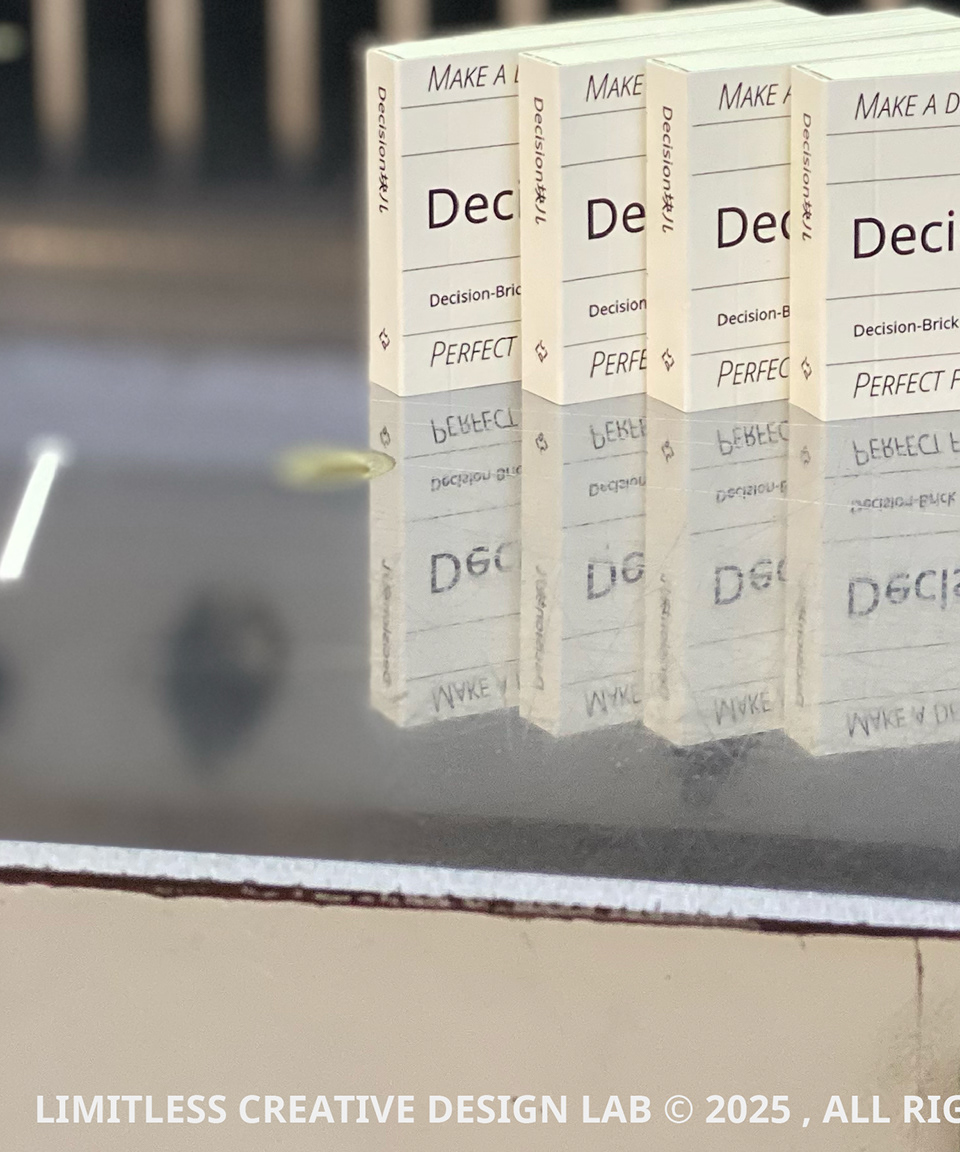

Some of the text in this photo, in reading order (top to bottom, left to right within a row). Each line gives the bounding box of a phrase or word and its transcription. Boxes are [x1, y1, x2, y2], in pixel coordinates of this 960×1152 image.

[922, 94, 937, 116] A
[853, 315, 959, 338] Decision-Brick
[430, 335, 518, 367] PERFECT
[853, 370, 946, 399] PERFECT
